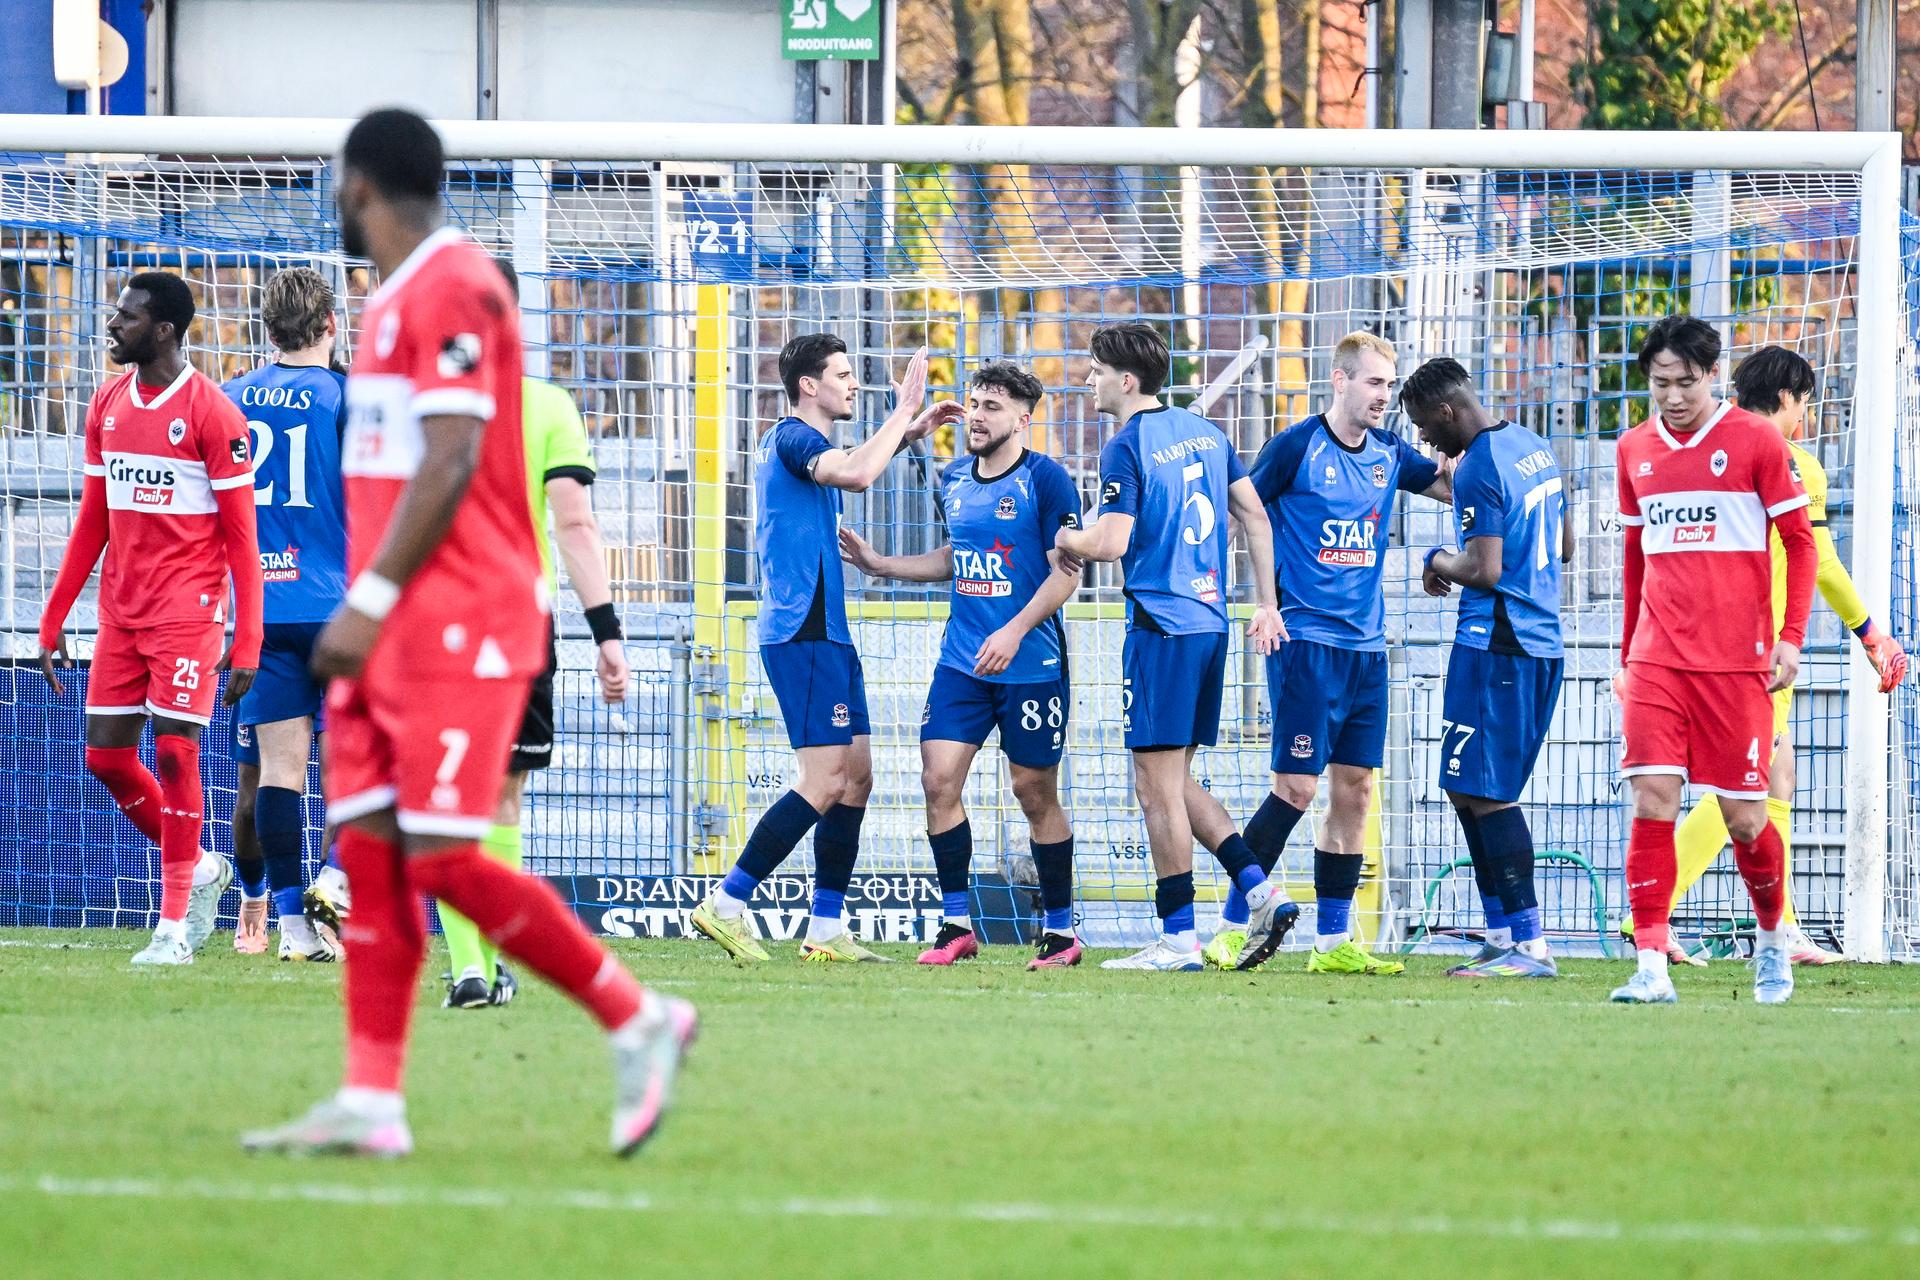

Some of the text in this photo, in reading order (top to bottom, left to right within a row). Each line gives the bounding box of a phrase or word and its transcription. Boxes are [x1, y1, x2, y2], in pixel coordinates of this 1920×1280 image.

[788, 38, 873, 50] NOODUITGANG
[241, 385, 312, 410] COOLS
[109, 458, 175, 486] Circus
[247, 419, 315, 508] 21
[135, 490, 169, 505] Daily
[1182, 461, 1216, 546] 5
[1648, 502, 1717, 526] Circus
[1319, 519, 1376, 549] STAR
[1676, 526, 1712, 543] Daily
[259, 552, 297, 570] STAR
[954, 549, 1008, 580] STAR
[1322, 550, 1364, 563] CASINO
[263, 570, 297, 580] CASINO
[957, 580, 1009, 594] CASINO TV
[1190, 575, 1218, 593] STAR
[172, 657, 200, 690] 25
[1020, 696, 1064, 731] 88
[1441, 718, 1476, 755] 77
[434, 727, 470, 783] 7
[1746, 737, 1760, 768] 4
[747, 774, 783, 789] VSS
[1112, 845, 1147, 860] VSS
